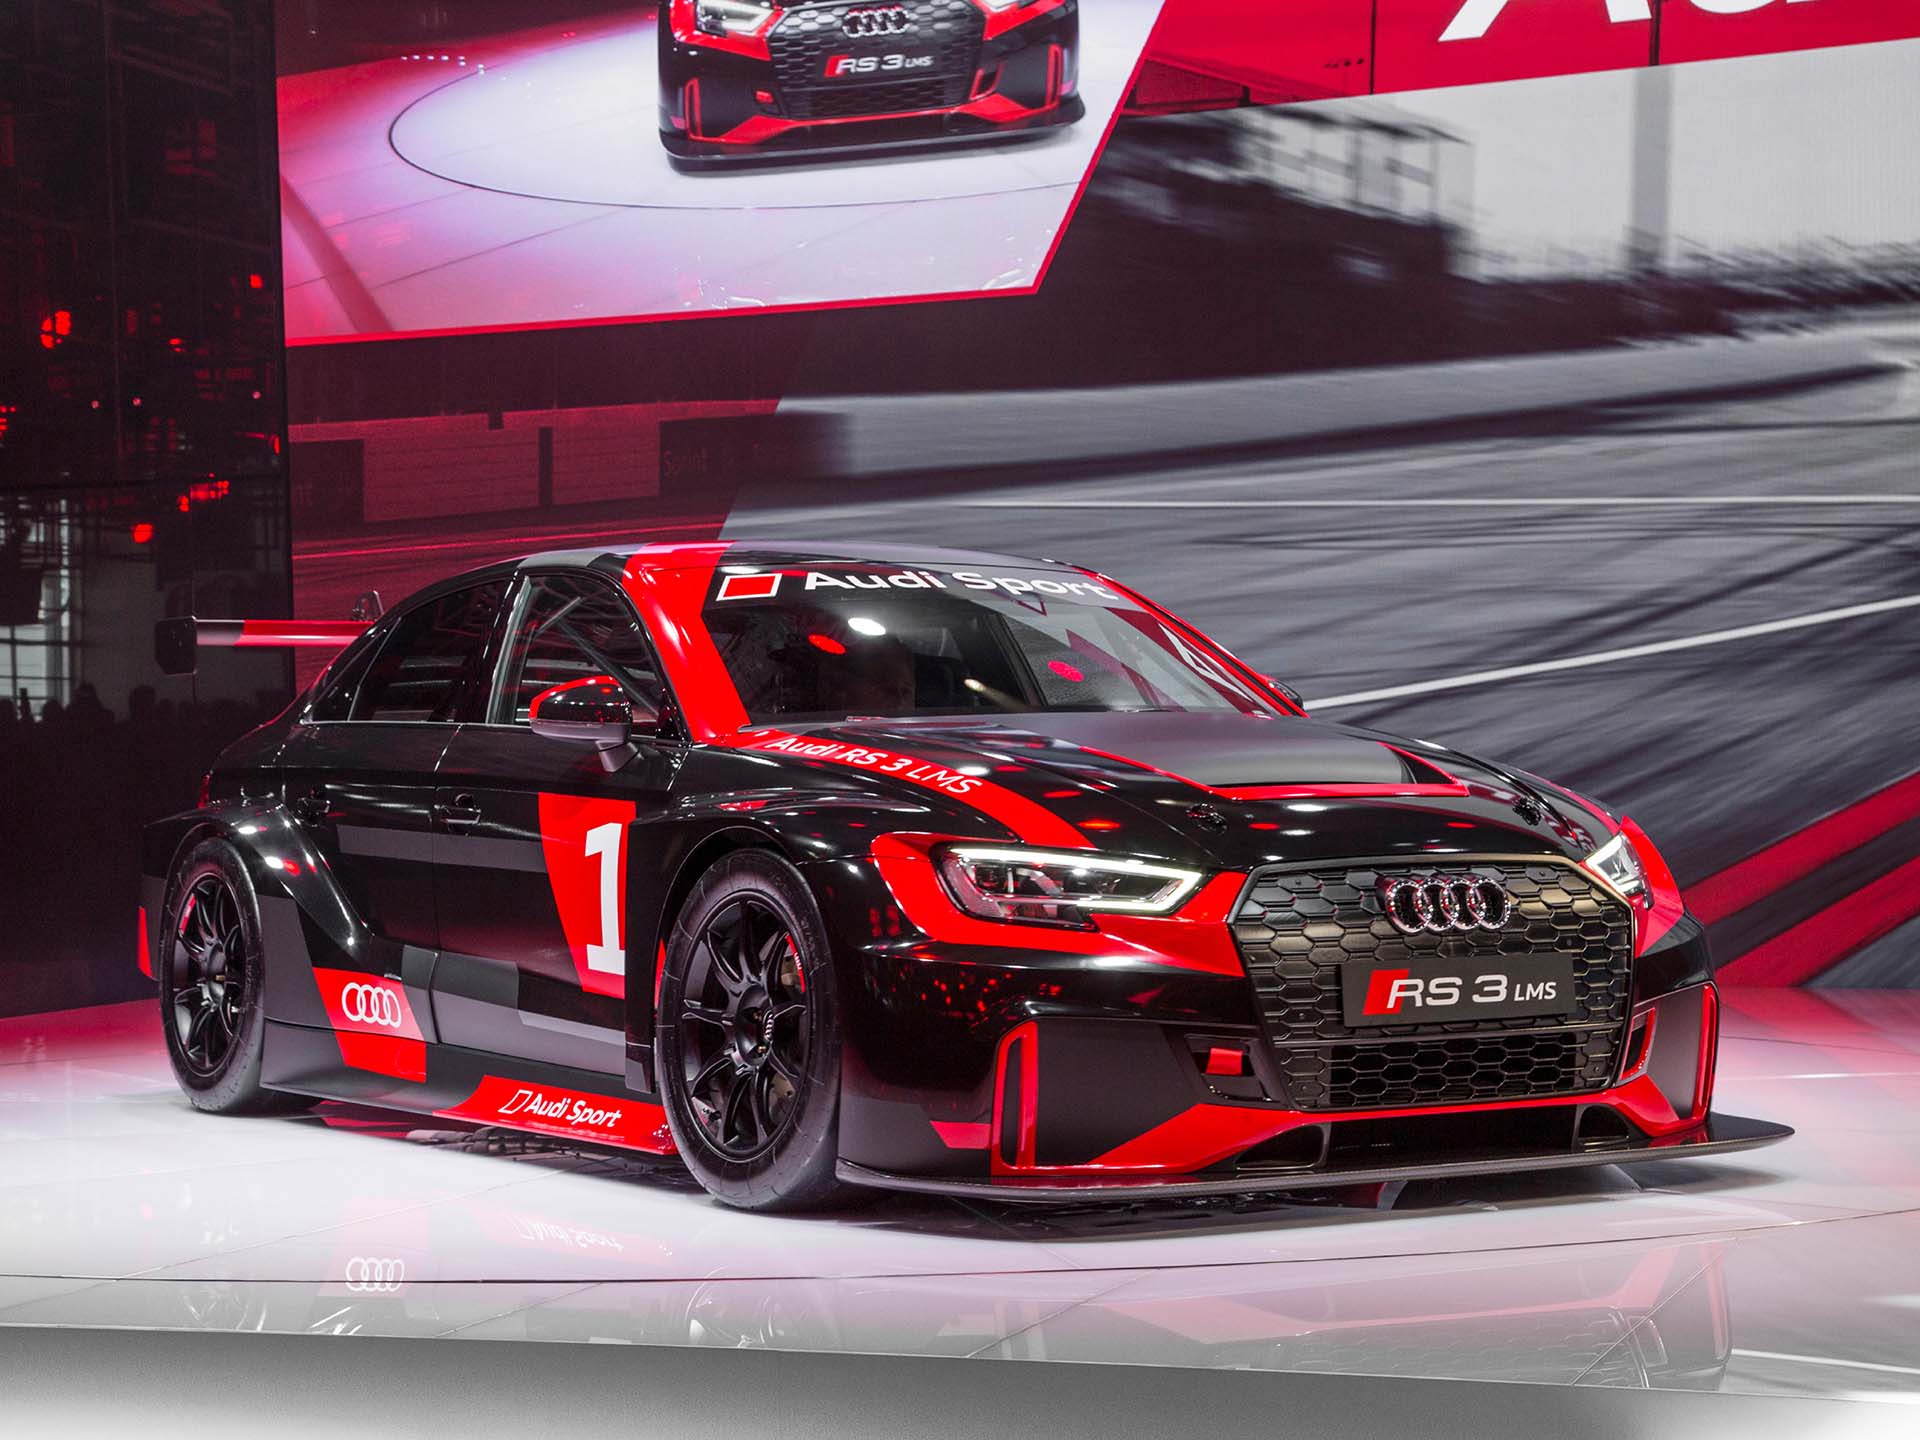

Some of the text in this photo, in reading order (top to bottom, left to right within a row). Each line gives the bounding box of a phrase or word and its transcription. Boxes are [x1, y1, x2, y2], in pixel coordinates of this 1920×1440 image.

[836, 54, 934, 74] RS 3 LMS
[804, 570, 1119, 600] Audi Sport
[768, 737, 983, 794] Audi RS 3 LMS
[585, 822, 625, 976] 1
[1386, 974, 1557, 1009] RS 3 LMS
[524, 1093, 622, 1127] Audi Sport
